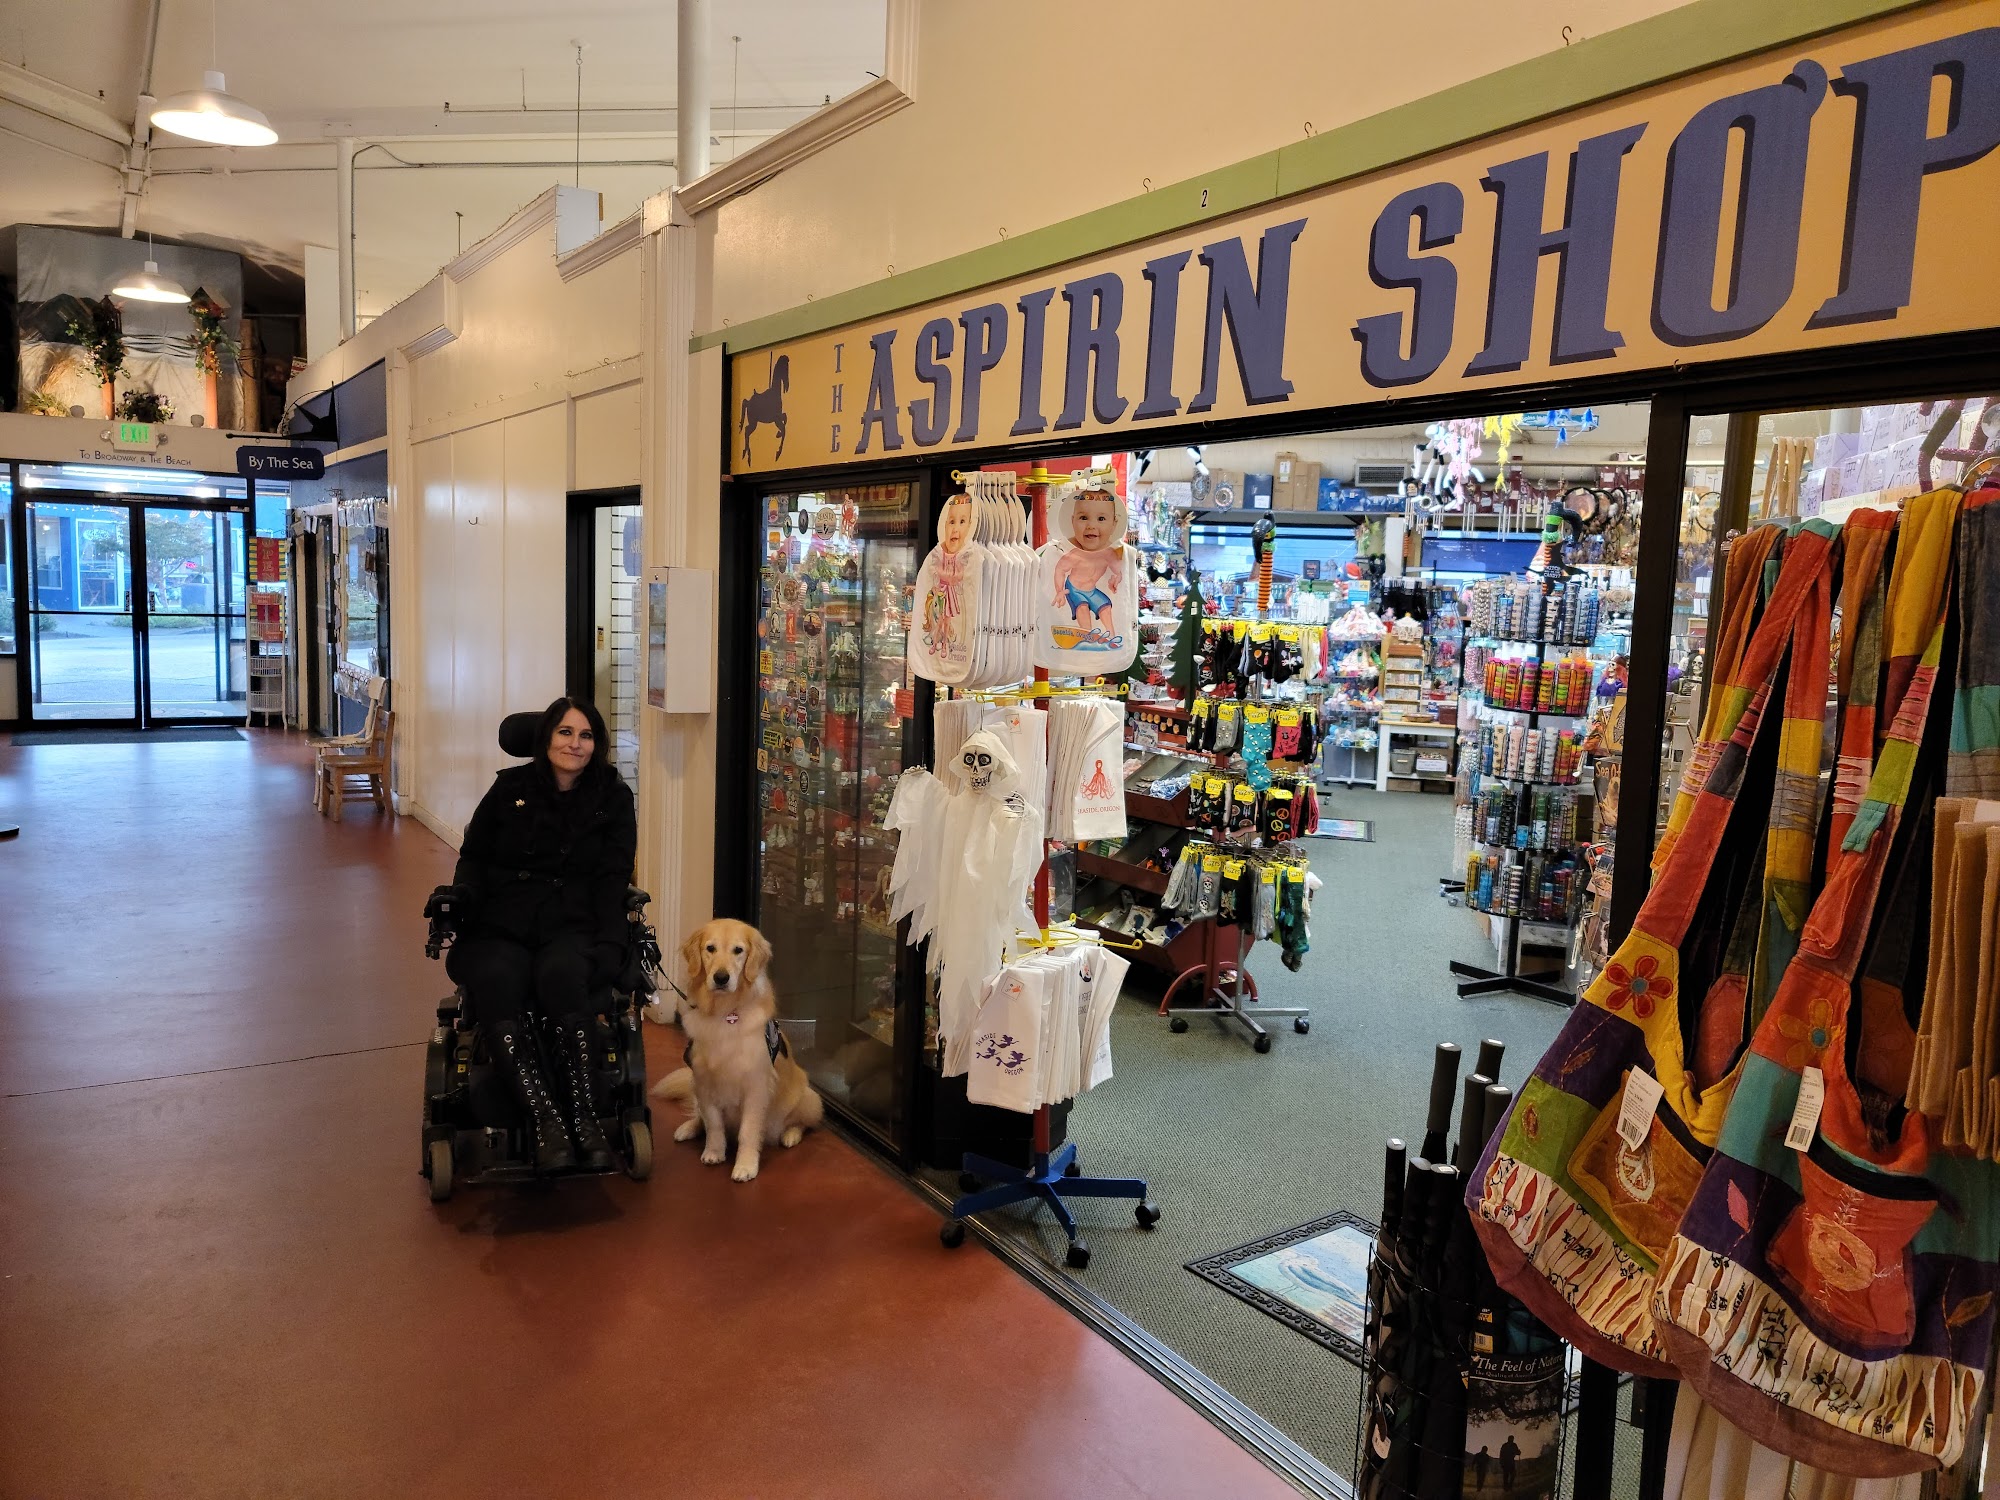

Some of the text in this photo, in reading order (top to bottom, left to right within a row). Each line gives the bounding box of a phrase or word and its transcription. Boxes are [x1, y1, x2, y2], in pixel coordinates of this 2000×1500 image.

[1201, 188, 1209, 208] 2
[830, 25, 2000, 455] THE ASPIRIN SHOP
[120, 423, 149, 444] EXIT
[79, 449, 91, 460] TO
[95, 451, 137, 463] BROADWAY
[149, 453, 162, 464] THE
[166, 455, 192, 466] BEACH
[248, 455, 314, 471] By The Sea
[975, 1032, 997, 1047] SEASIDE
[1477, 1356, 1498, 1371] The
[1500, 1360, 1524, 1372] Feel
[1525, 1359, 1538, 1374] of
